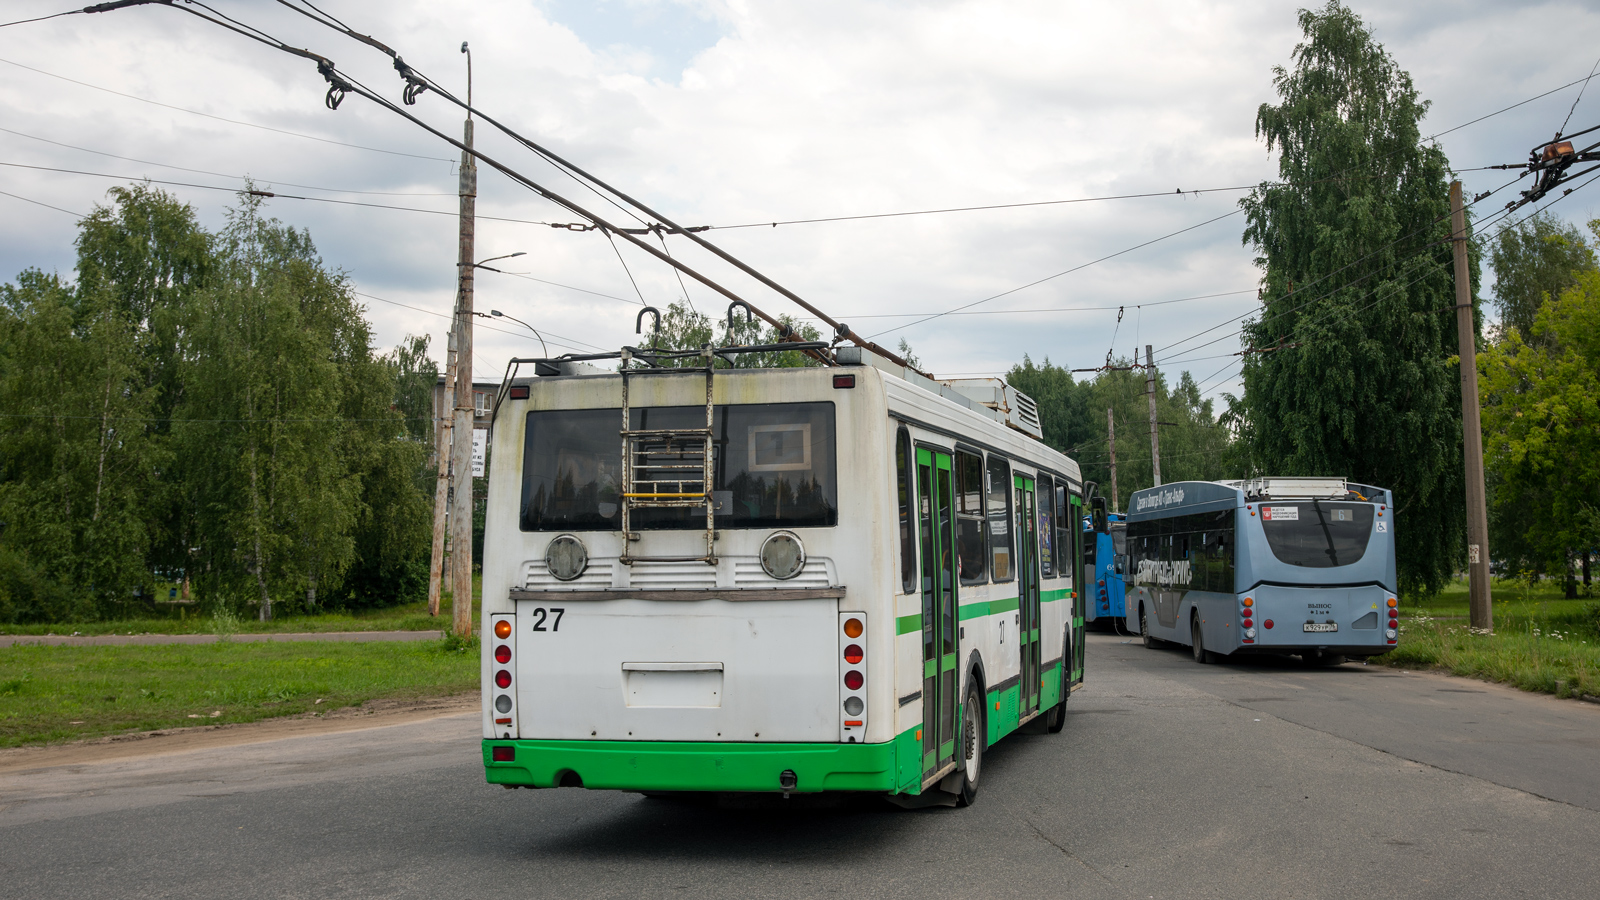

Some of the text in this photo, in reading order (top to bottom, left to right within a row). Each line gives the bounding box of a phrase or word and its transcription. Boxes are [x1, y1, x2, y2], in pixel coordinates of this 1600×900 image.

[1338, 509, 1345, 521] 6
[533, 607, 565, 632] 27
[998, 620, 1005, 645] 27
